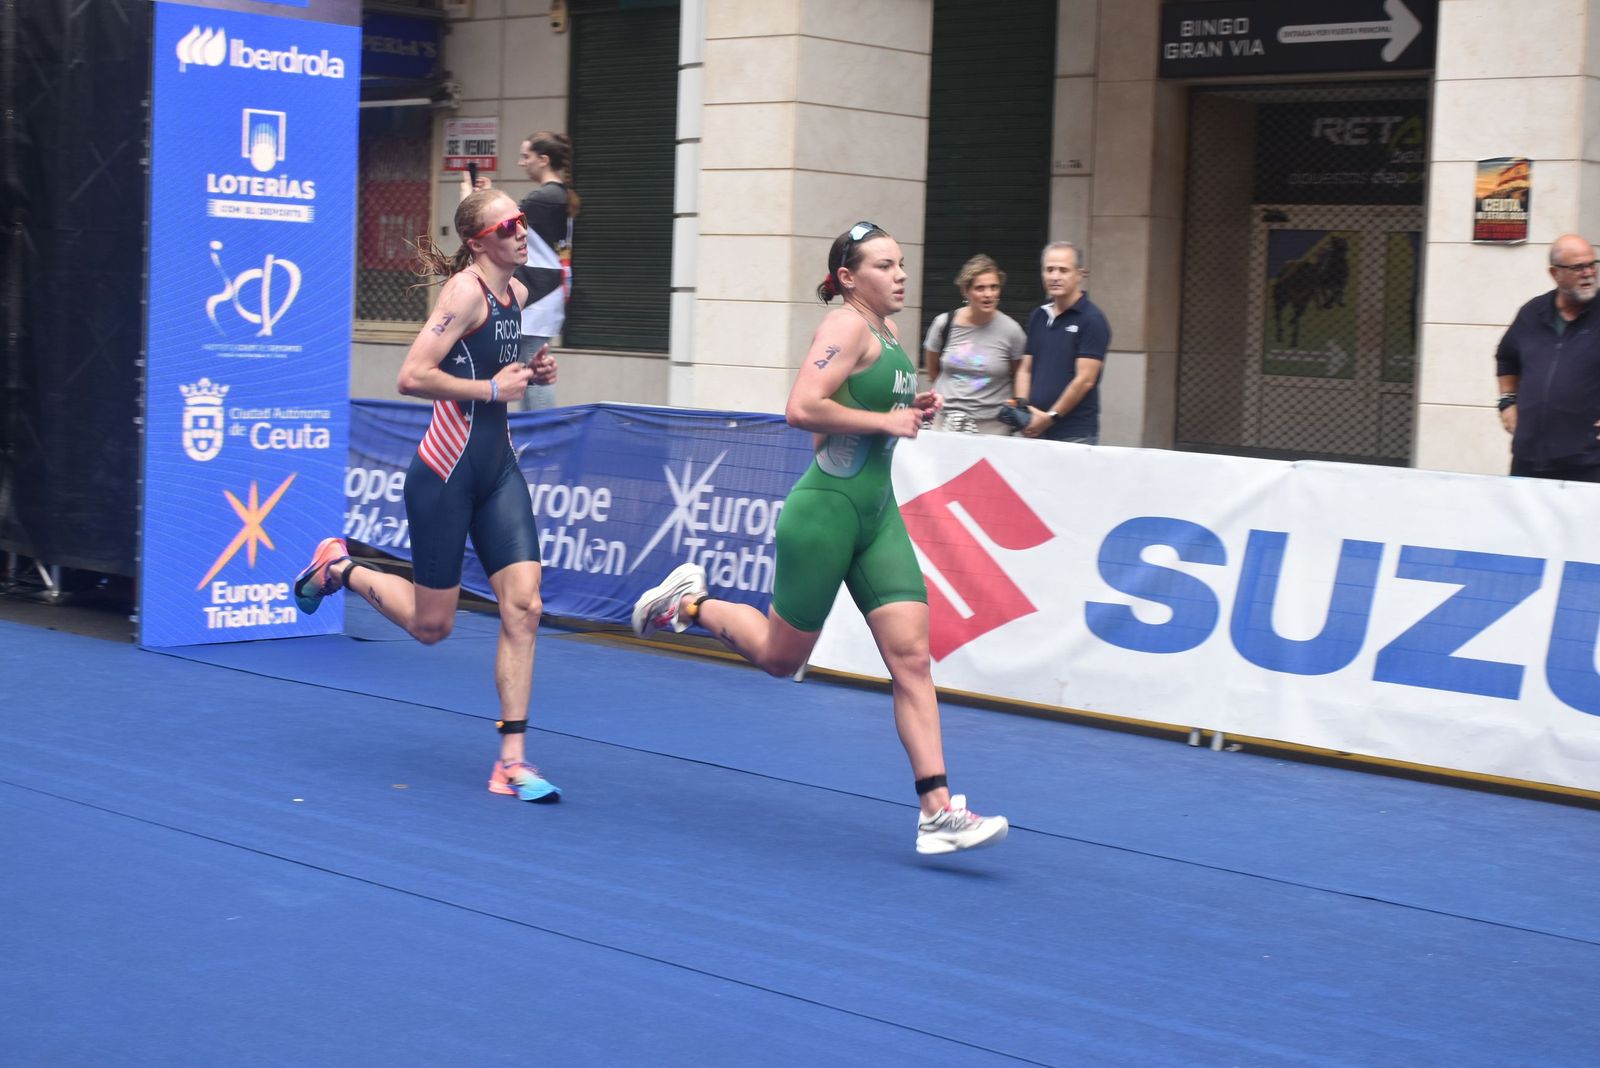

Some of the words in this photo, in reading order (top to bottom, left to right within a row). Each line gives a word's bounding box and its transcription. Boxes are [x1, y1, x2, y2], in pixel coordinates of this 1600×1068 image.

[1180, 17, 1249, 37] BINGO
[229, 38, 345, 79] Iberdrola
[1164, 41, 1223, 59] GRAN
[1228, 39, 1265, 57] VIA
[206, 173, 316, 200] LOTERÍAS
[495, 319, 522, 341] RICCA
[499, 344, 518, 364] USA
[229, 407, 272, 419] Ciudad
[229, 422, 247, 436] de
[250, 422, 331, 450] Ceuta
[344, 467, 407, 505] ope
[211, 580, 289, 605] Europe
[203, 603, 297, 629] Triathlon
